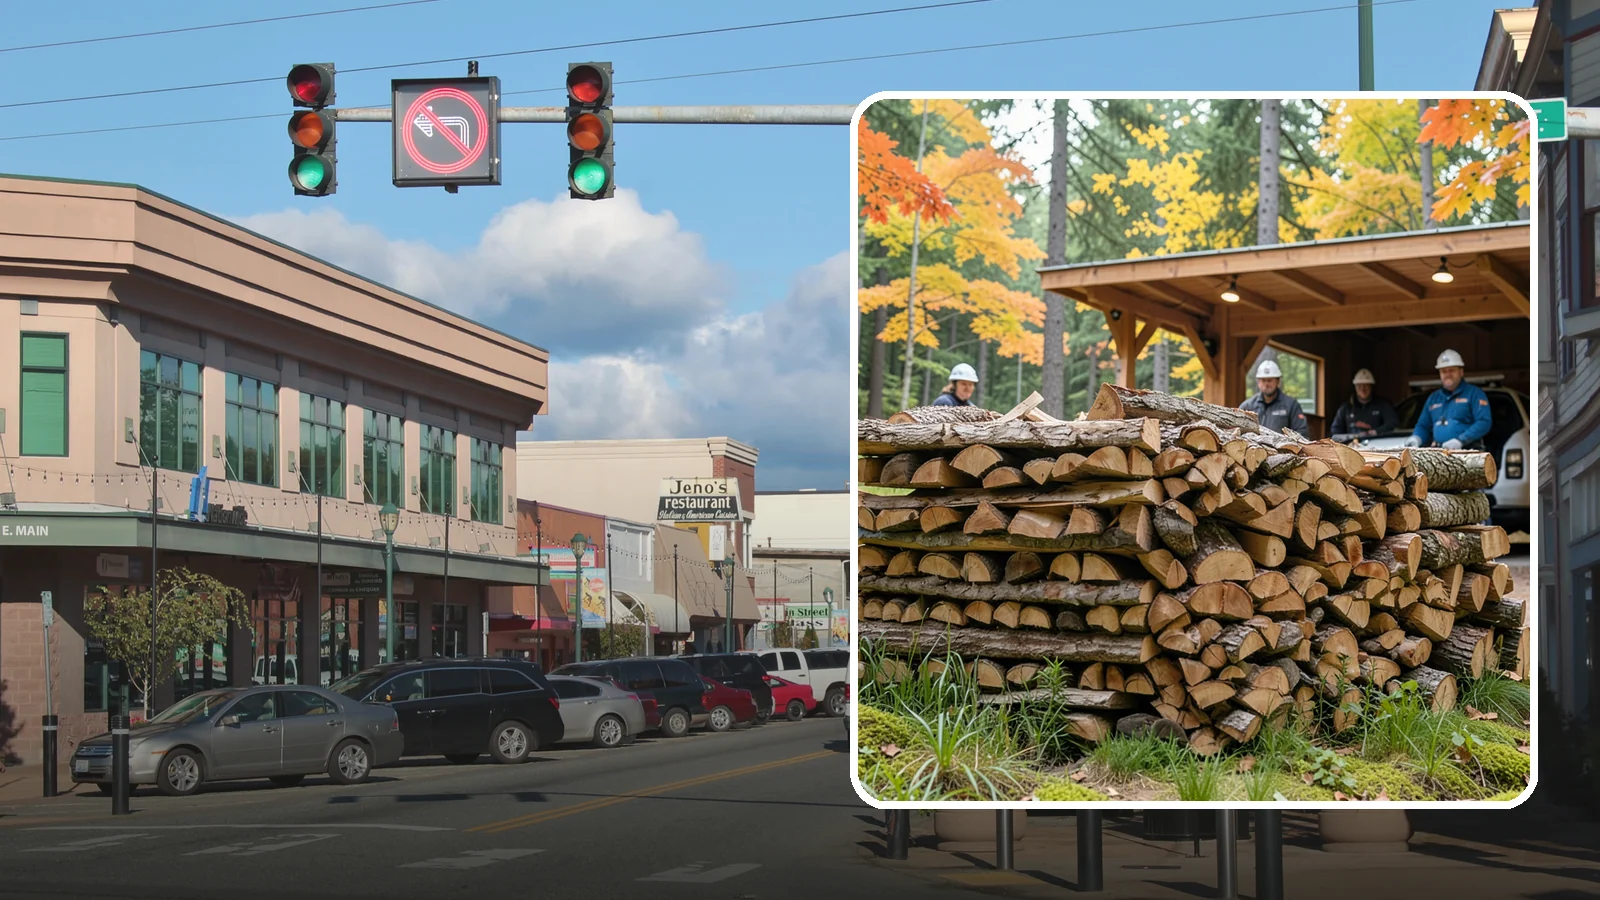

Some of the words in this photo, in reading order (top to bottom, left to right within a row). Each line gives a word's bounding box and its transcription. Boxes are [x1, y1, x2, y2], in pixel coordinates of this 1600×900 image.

[670, 480, 727, 494] Jeno's
[665, 496, 731, 509] restaurant
[658, 509, 682, 520] Italian
[685, 509, 715, 519] American
[715, 509, 738, 519] Cuisine
[2, 525, 13, 536] E.
[15, 525, 49, 536] MAIN
[785, 607, 794, 616] in
[797, 607, 828, 617] Street
[790, 619, 823, 627] lass
